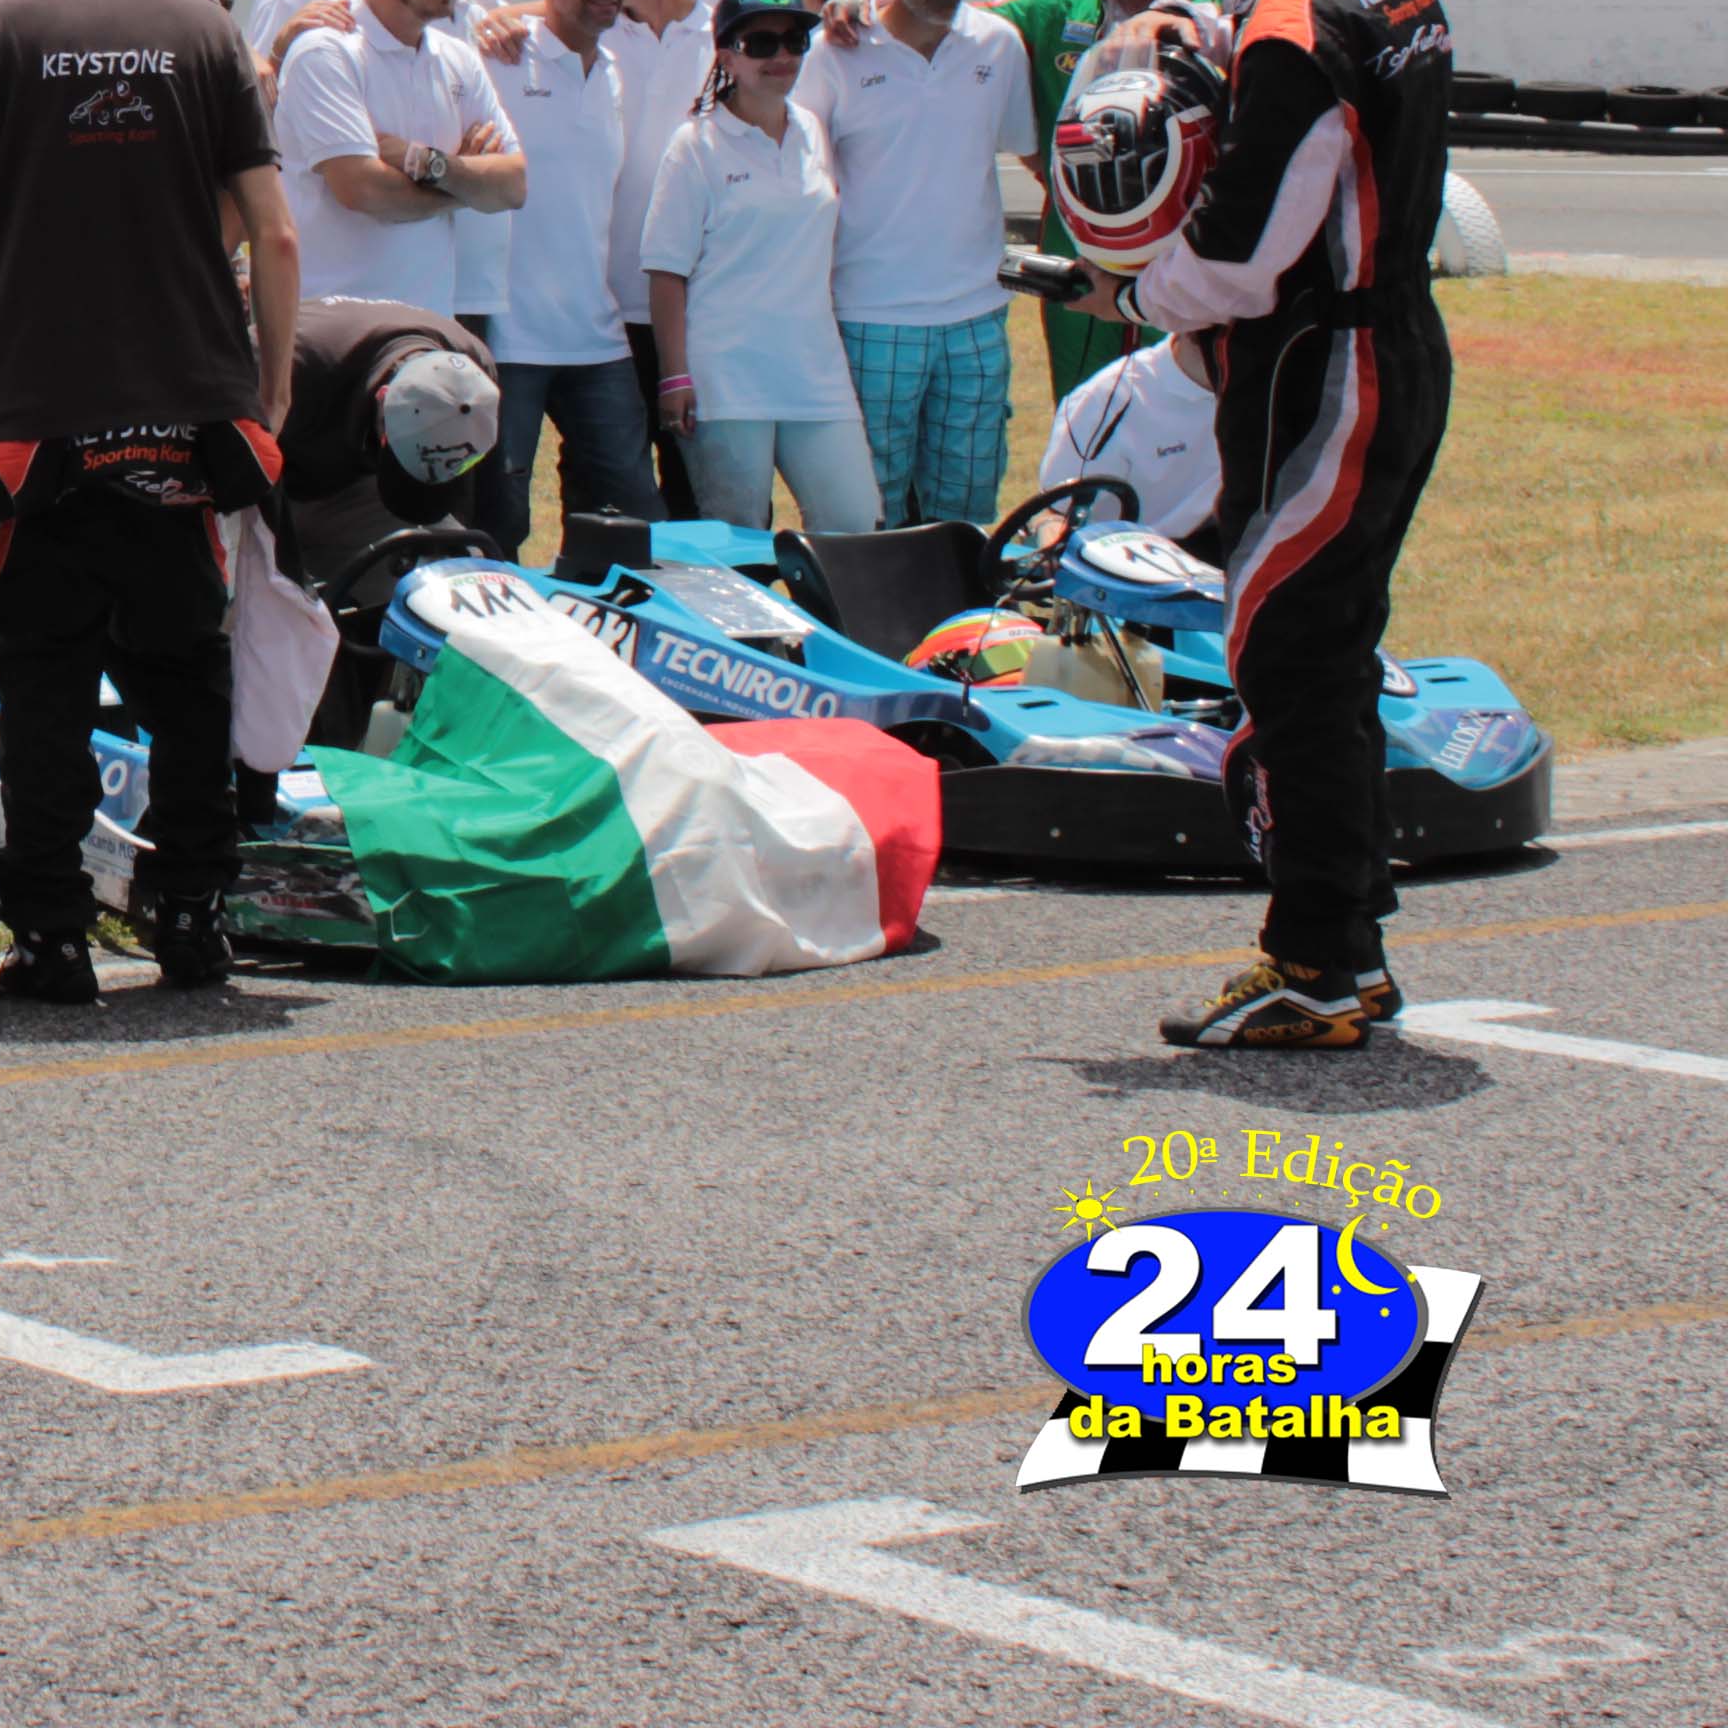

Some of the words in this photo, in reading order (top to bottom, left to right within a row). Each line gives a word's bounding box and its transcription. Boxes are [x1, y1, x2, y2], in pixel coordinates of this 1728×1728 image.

[42, 49, 177, 80] KEYSTONE
[83, 444, 157, 471] Sporting
[160, 443, 193, 464] Kart
[450, 580, 533, 618] 111
[652, 631, 840, 719] TECNIROLO
